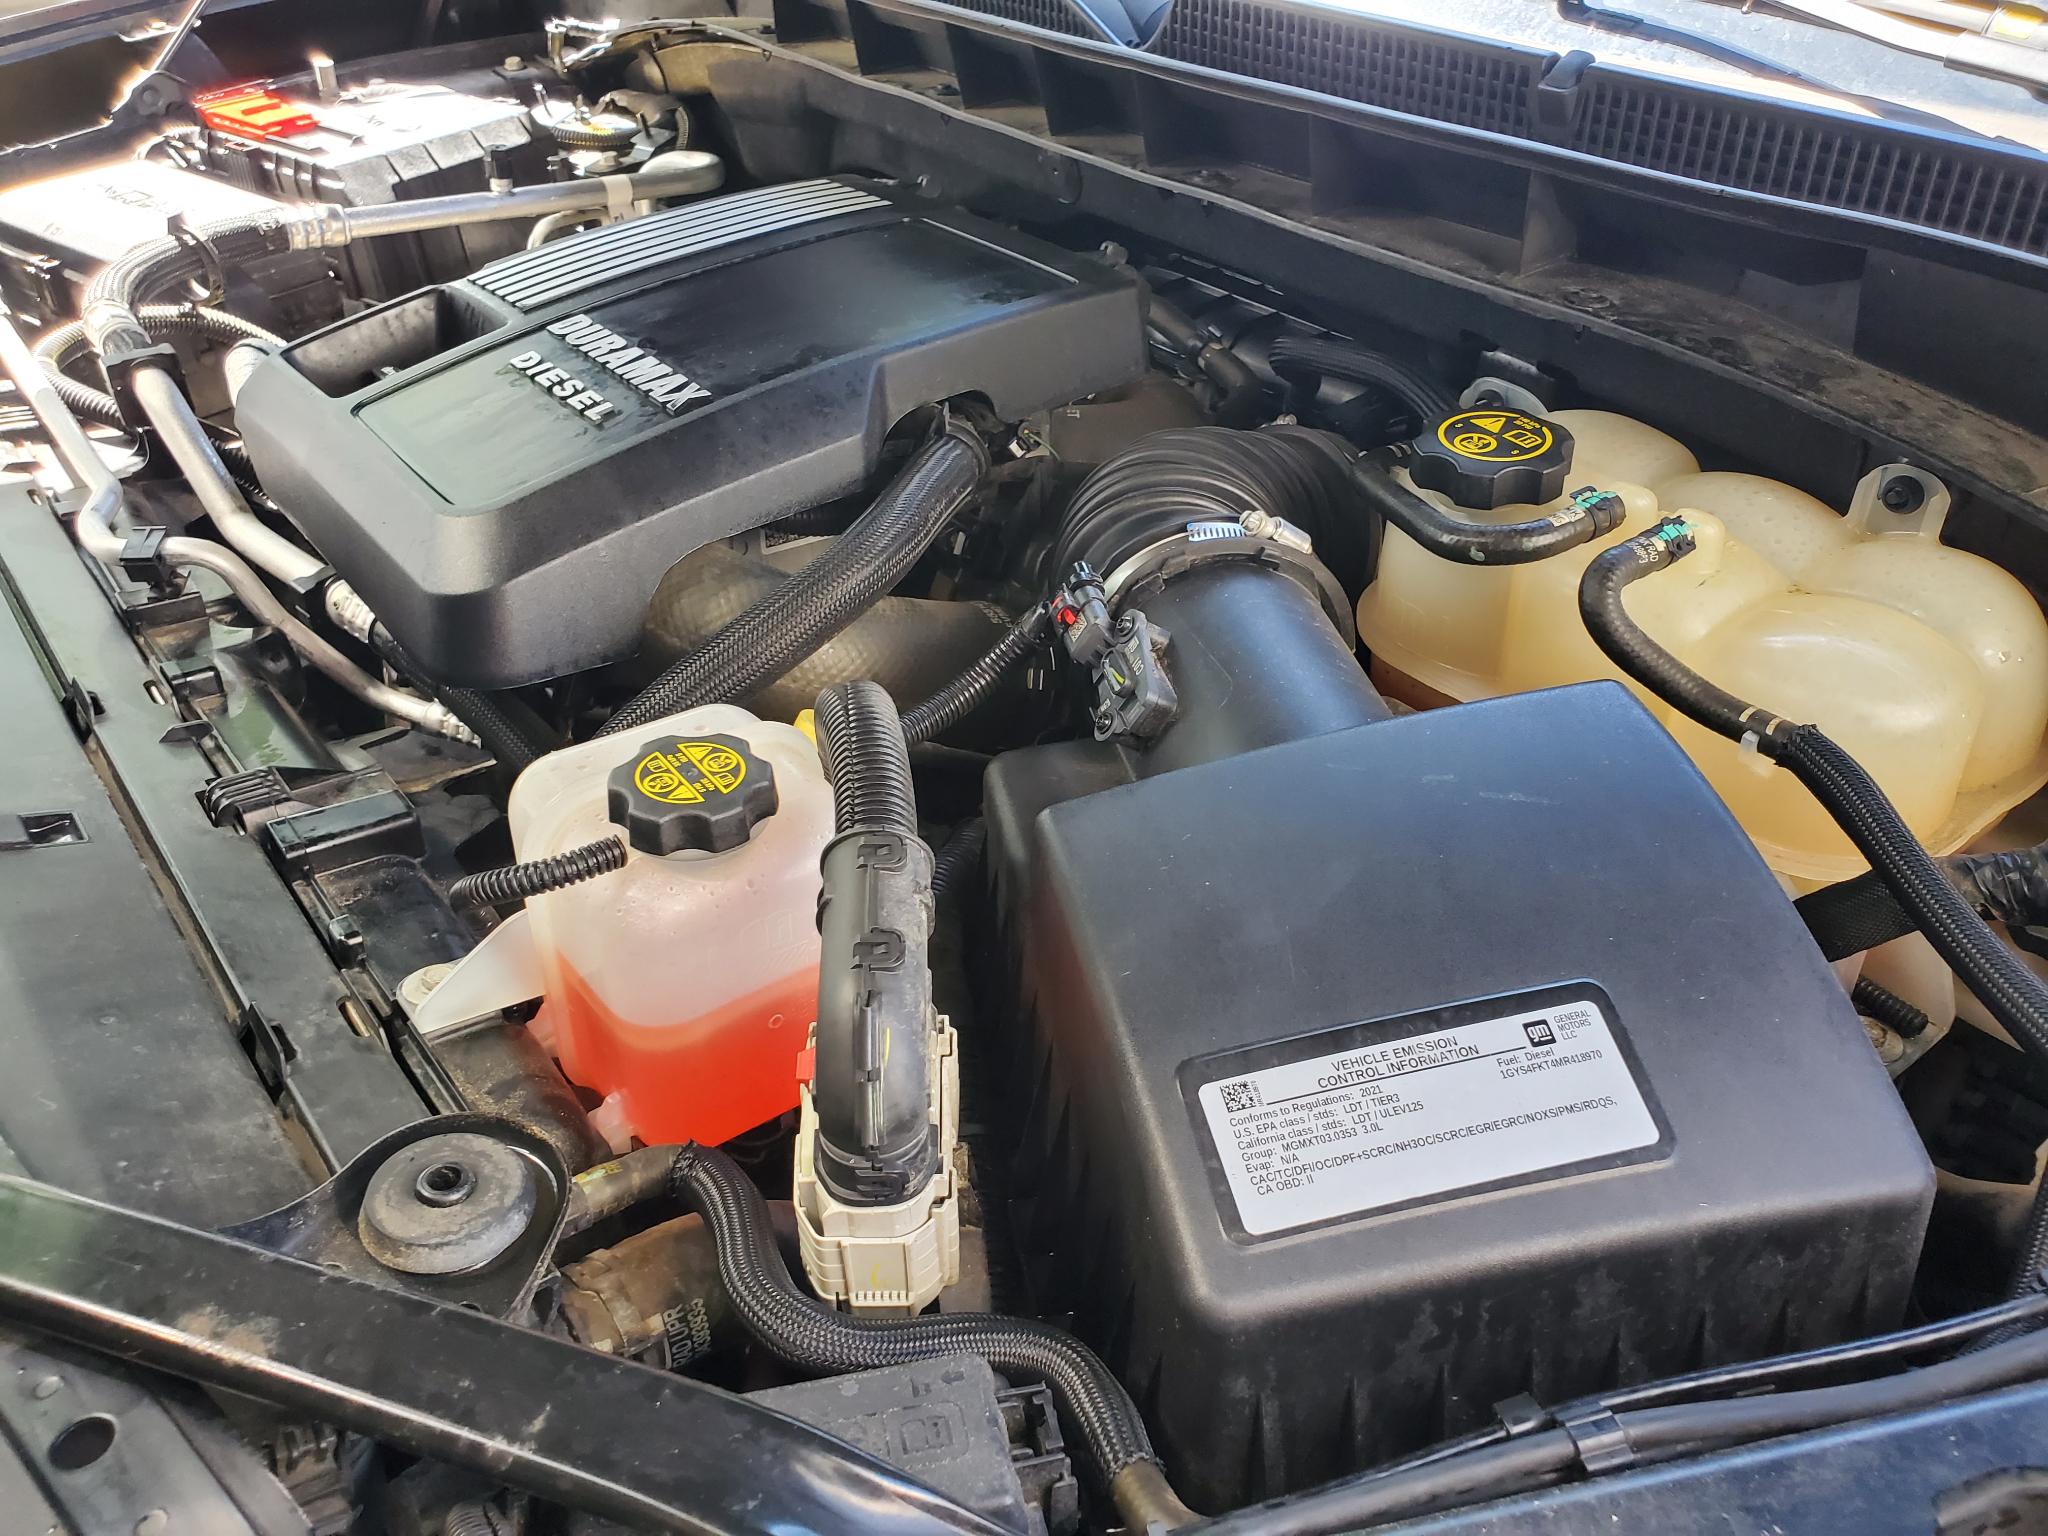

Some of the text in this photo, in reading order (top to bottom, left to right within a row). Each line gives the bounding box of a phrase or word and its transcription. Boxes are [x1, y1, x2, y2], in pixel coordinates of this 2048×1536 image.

[547, 313, 712, 414] DURAMAX
[509, 350, 614, 423] DIESEL
[1526, 1023, 1553, 1043] gm
[1553, 1009, 1591, 1024] GENERAL
[1557, 1018, 1592, 1032] MOTORS
[1331, 1035, 1458, 1072] VEHICLE EMISSION
[1561, 1030, 1578, 1041] LLC
[1317, 1044, 1480, 1089] CONTROL INFORMATION
[1496, 1047, 1555, 1068] Fuel: Diesel
[1500, 1049, 1603, 1079] 1GYS4FKT4MR418970
[1229, 1085, 1383, 1127] Conforms to Regulations: 2021
[1233, 1125, 1255, 1139] U.S.
[1256, 1121, 1278, 1134] EPA
[1280, 1115, 1305, 1128] class
[1313, 1107, 1339, 1121] stds:
[1343, 1101, 1365, 1114] LDT
[1372, 1093, 1400, 1108] TIER3
[1237, 1132, 1286, 1150] California
[1288, 1126, 1313, 1139] class
[1321, 1118, 1347, 1131] stds:
[1351, 1112, 1373, 1125] LDT
[1379, 1101, 1424, 1119] ULEV125
[1241, 1122, 1383, 1162] Group: MGMXT03.0353 3.0L
[1245, 1153, 1300, 1173] Evap: N/A
[1257, 1184, 1274, 1196] CA
[1276, 1179, 1305, 1191] OBD:
[664, 1304, 689, 1343] UPR
